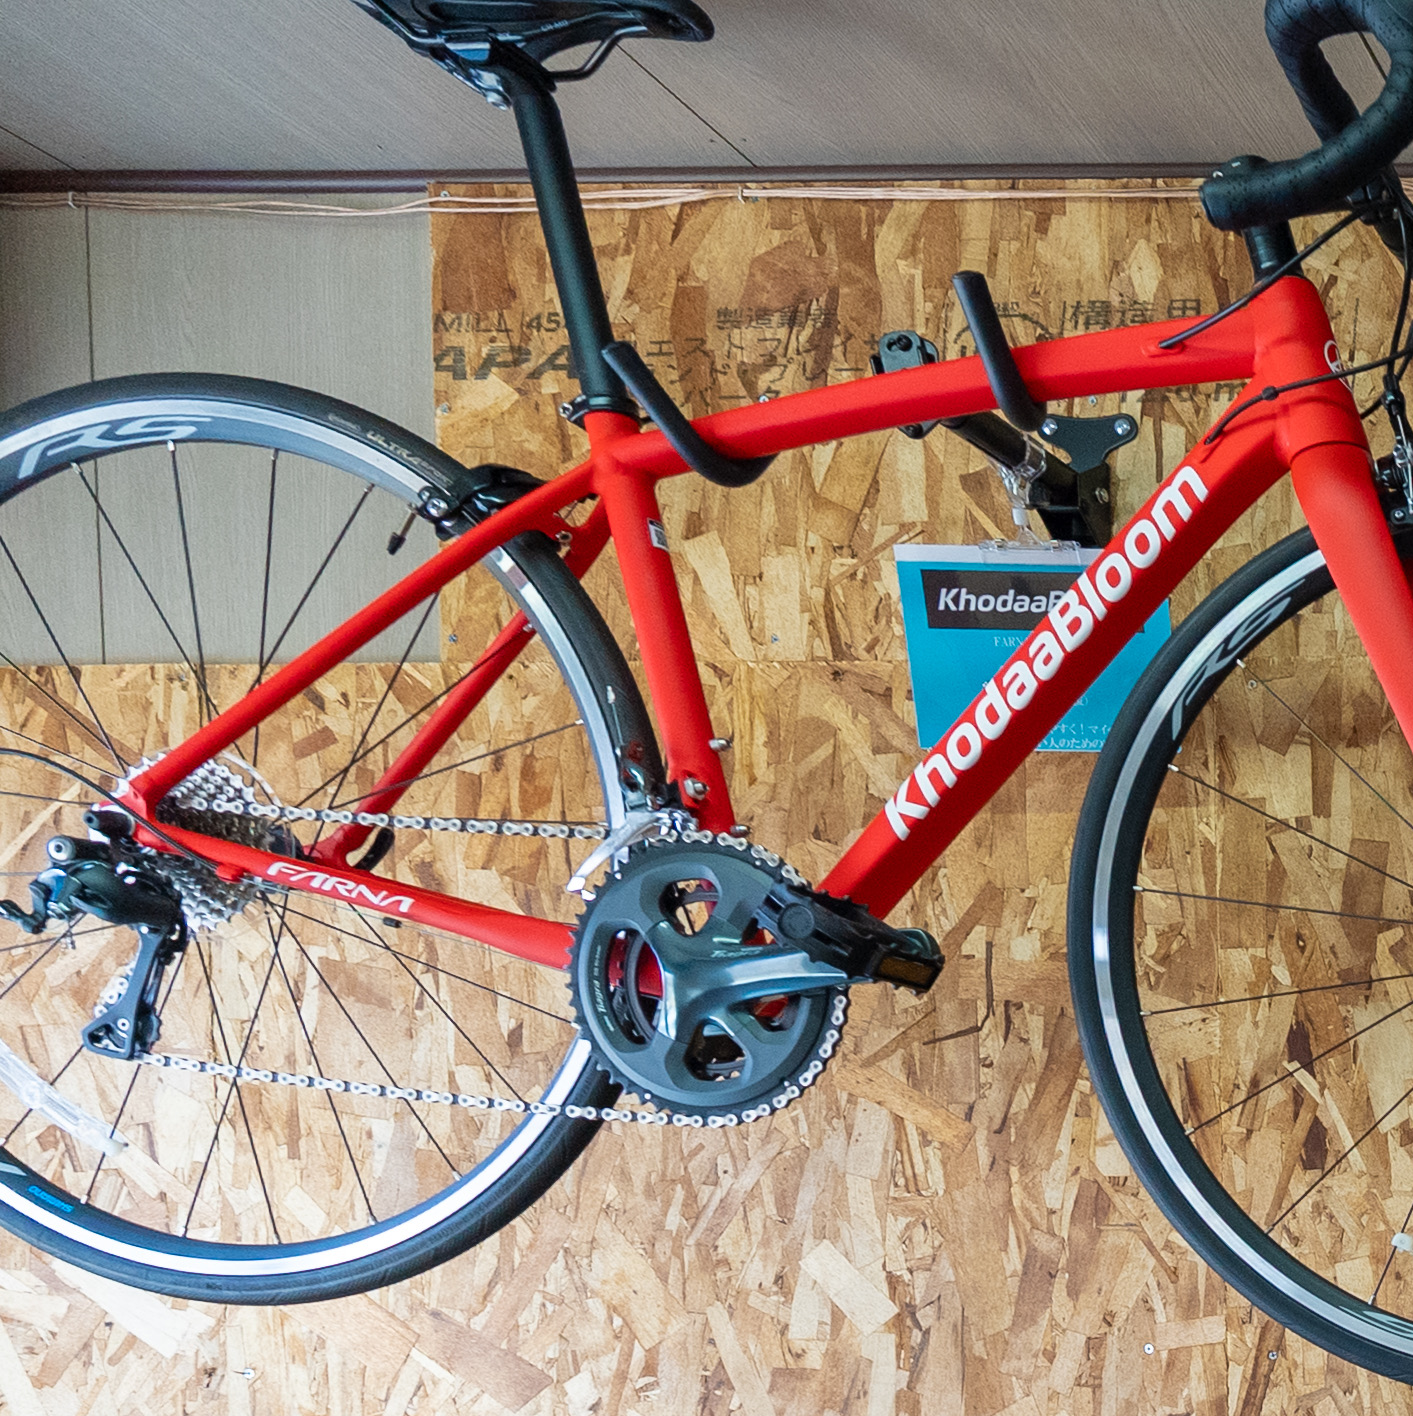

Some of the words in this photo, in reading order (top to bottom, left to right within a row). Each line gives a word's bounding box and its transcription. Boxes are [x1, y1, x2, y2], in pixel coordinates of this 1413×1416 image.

[884, 464, 1209, 840] KhodaaBloom
[993, 635, 1026, 649] FARN
[266, 860, 415, 915] FARNA
